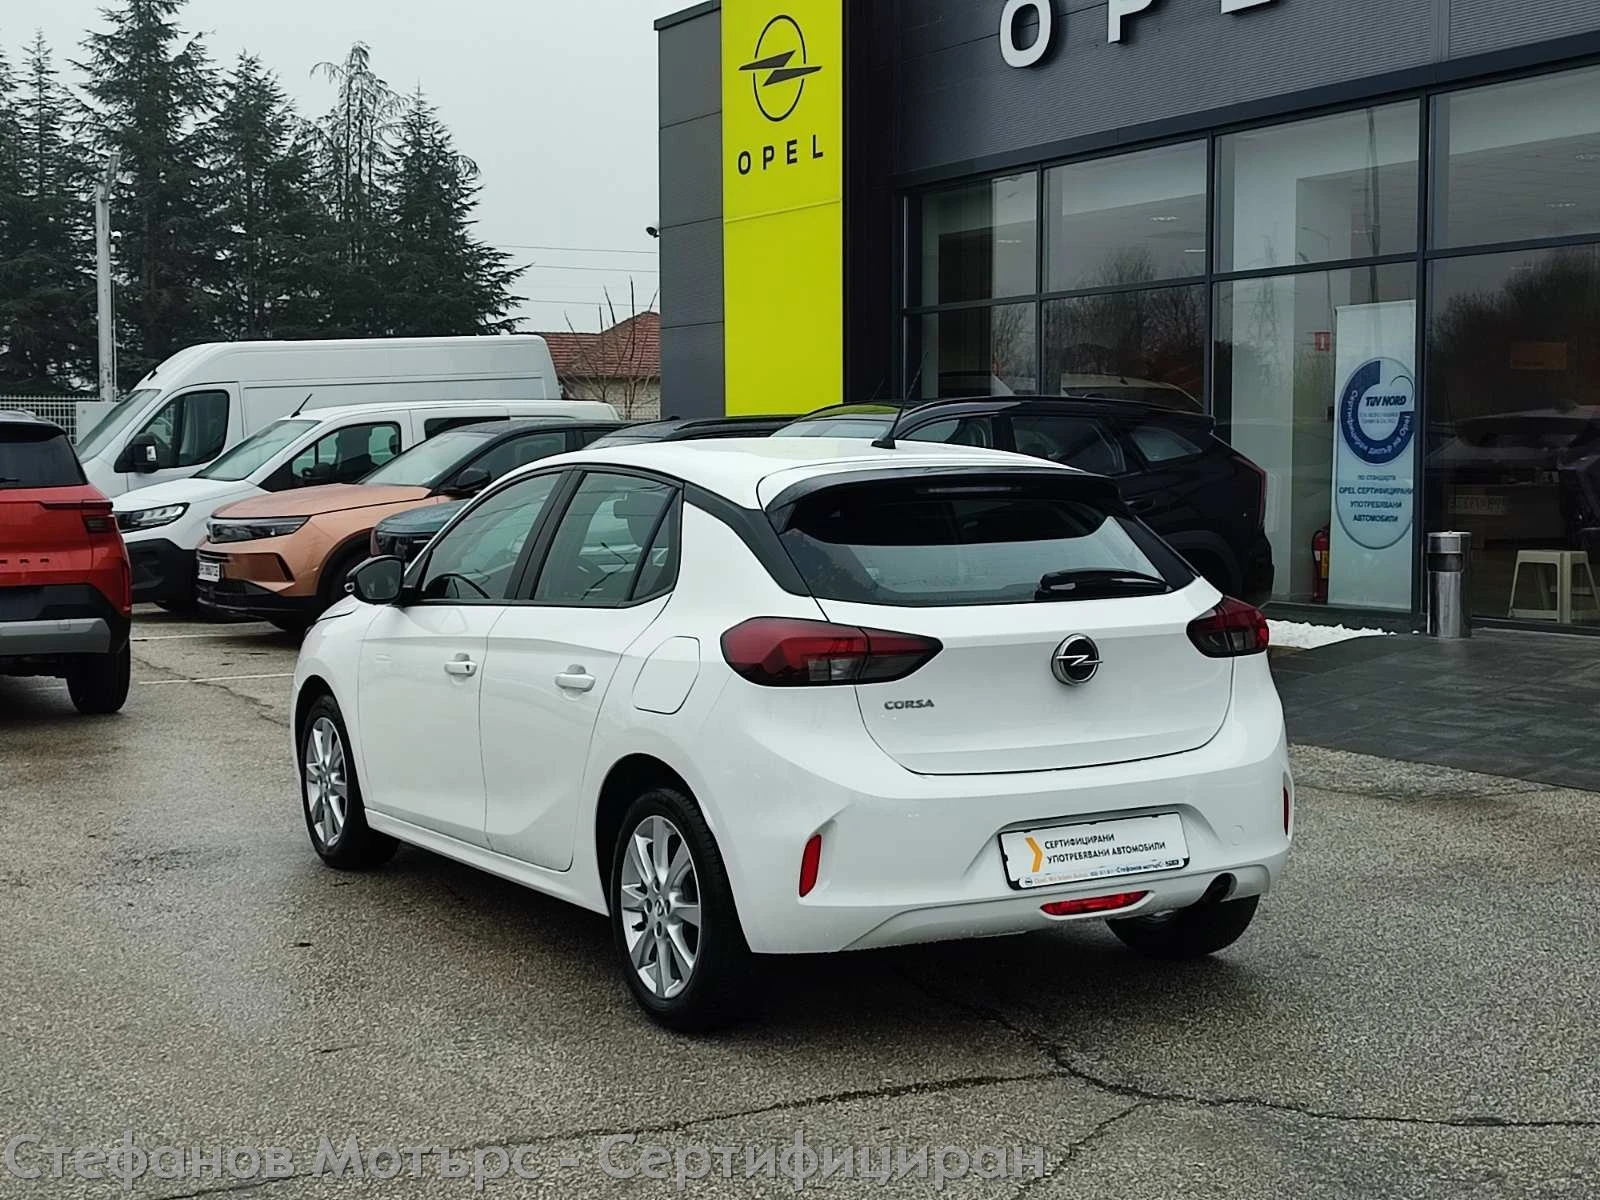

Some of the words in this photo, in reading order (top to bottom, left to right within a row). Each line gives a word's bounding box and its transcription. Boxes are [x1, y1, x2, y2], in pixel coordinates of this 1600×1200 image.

[737, 134, 824, 176] OPEL
[1382, 395, 1407, 407] NORD
[1338, 486, 1356, 495] OPEL
[1352, 514, 1398, 522] АВТОМОБИЛИ
[884, 699, 935, 710] CORSA
[1044, 833, 1116, 850] СЕРТИФИЦИРАНИ
[1046, 848, 1111, 865] УПОТРЕБЯВАНИ
[1111, 841, 1166, 856] АВТОМОБИЛИ
